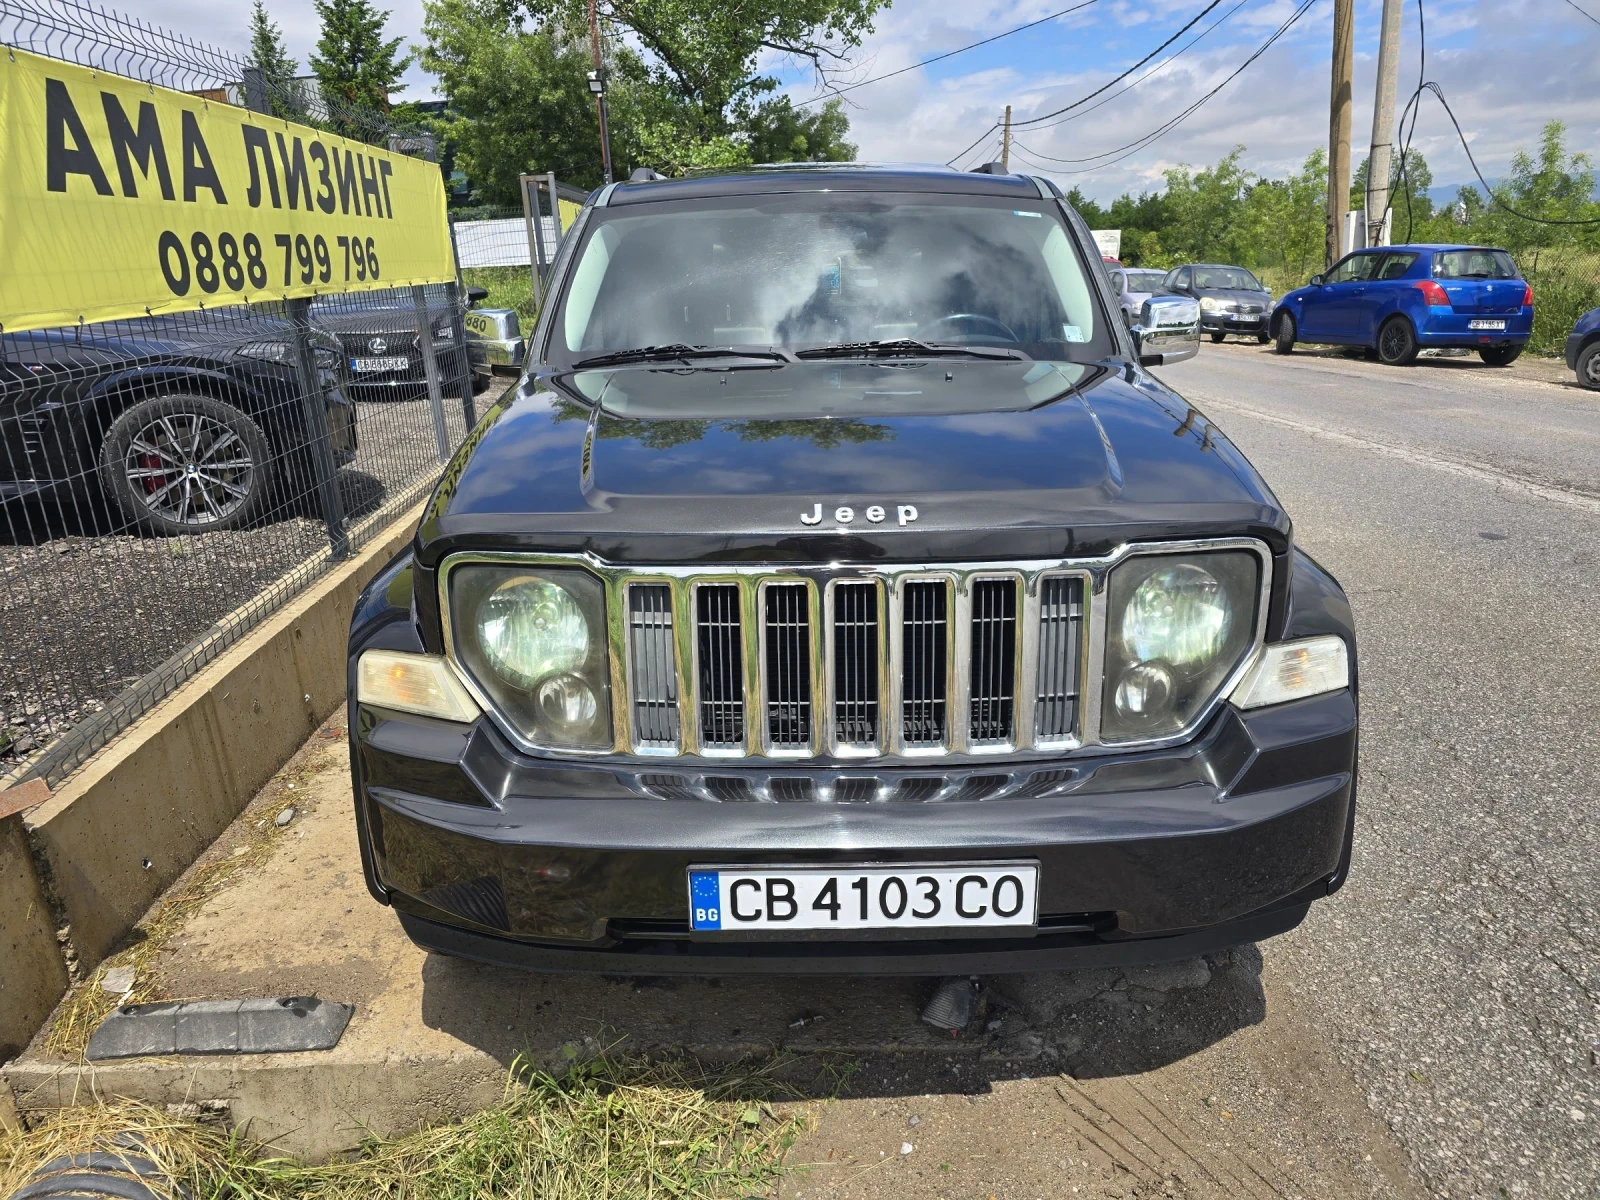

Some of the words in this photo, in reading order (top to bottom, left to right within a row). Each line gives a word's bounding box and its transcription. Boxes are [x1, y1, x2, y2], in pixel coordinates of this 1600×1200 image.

[46, 78, 228, 205] АМА
[242, 124, 393, 219] ЛИЗИНГ
[159, 231, 267, 297] 0888
[275, 234, 332, 287] 799
[337, 236, 380, 282] 796
[800, 503, 919, 526] Jeep
[696, 908, 719, 922] BG
[730, 878, 799, 922] CB
[812, 876, 941, 920] 4103
[955, 875, 1024, 919] CO
